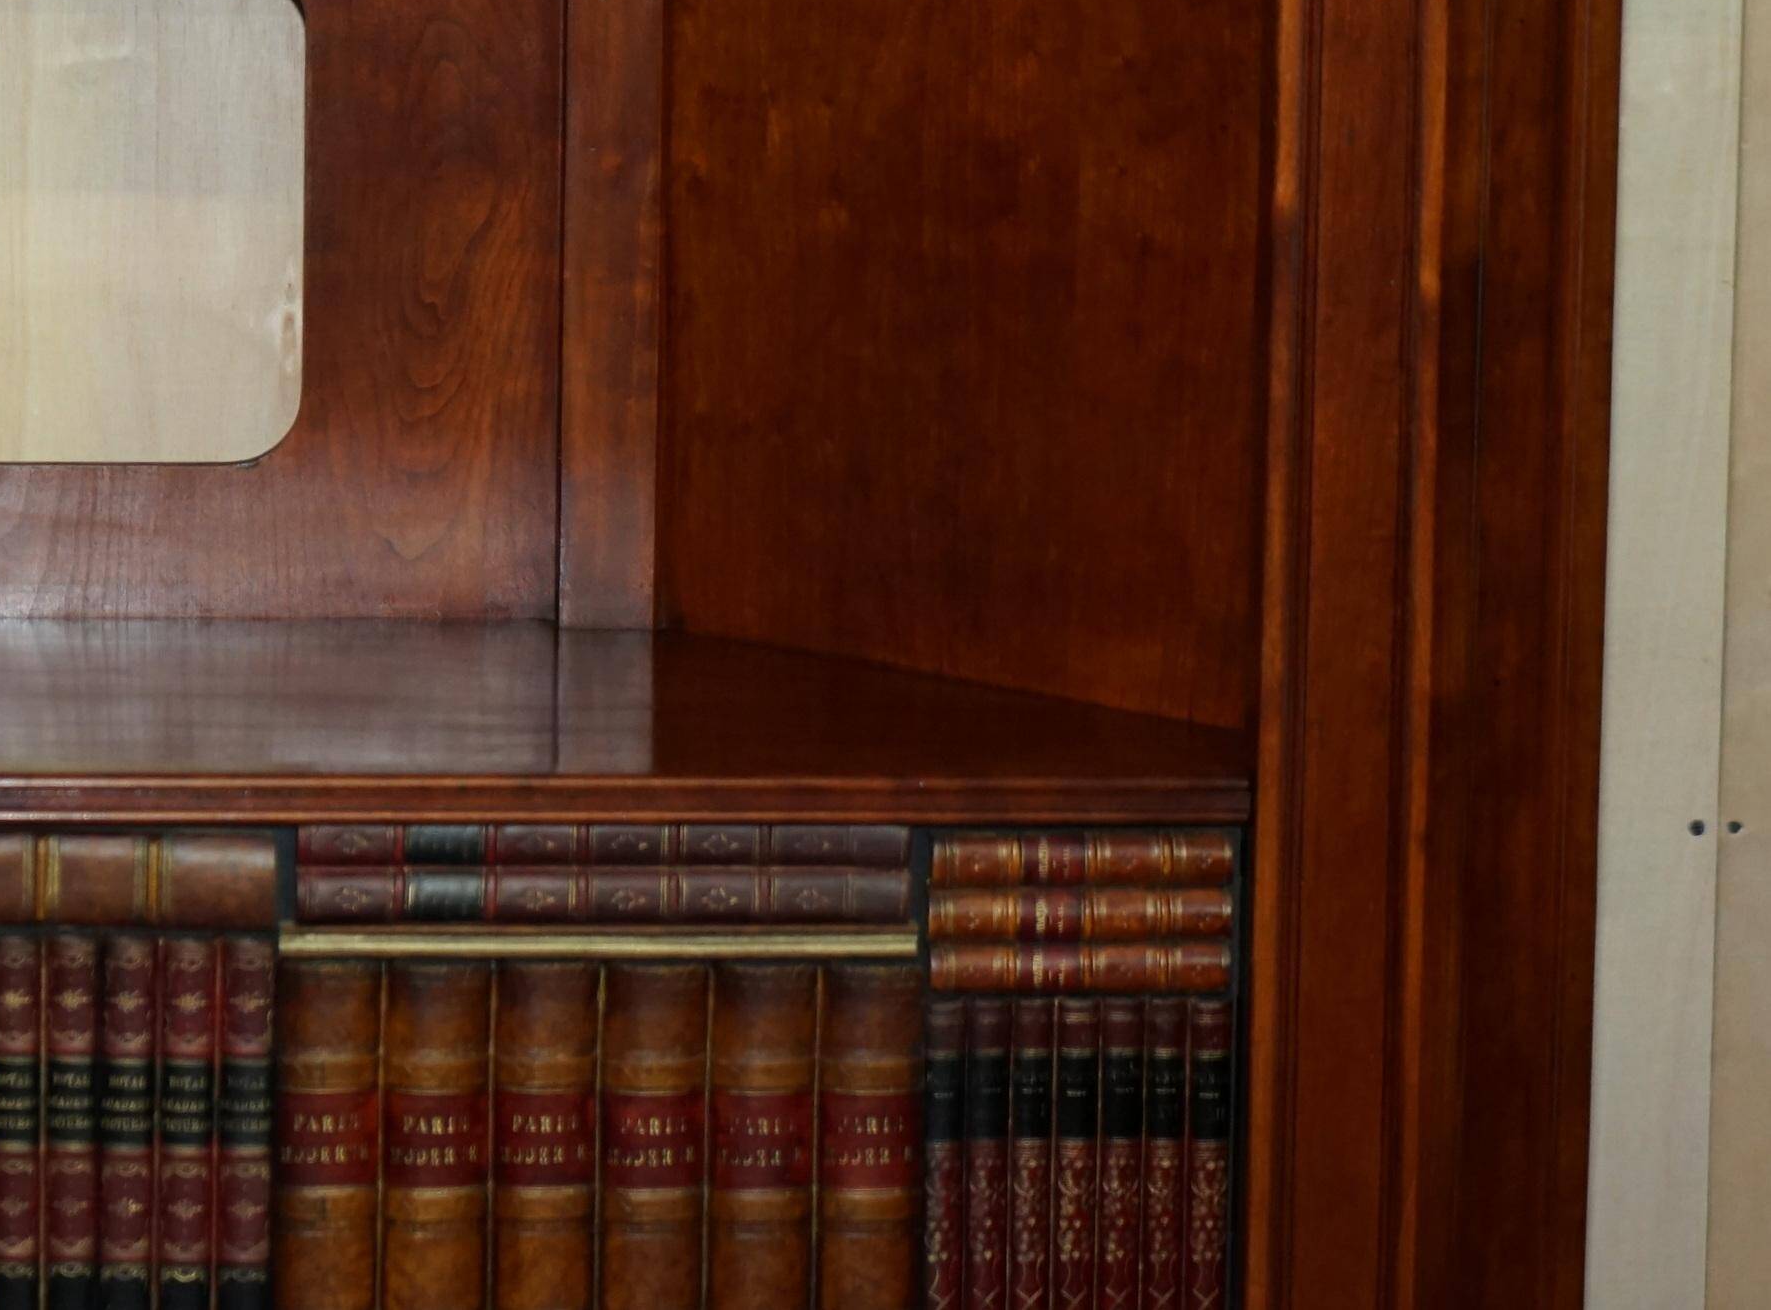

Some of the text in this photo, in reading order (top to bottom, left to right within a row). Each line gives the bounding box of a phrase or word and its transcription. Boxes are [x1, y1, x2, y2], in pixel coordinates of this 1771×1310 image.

[294, 1113, 359, 1133] PARIS
[403, 1114, 469, 1135] PARIS
[390, 1144, 478, 1167] MODERE
